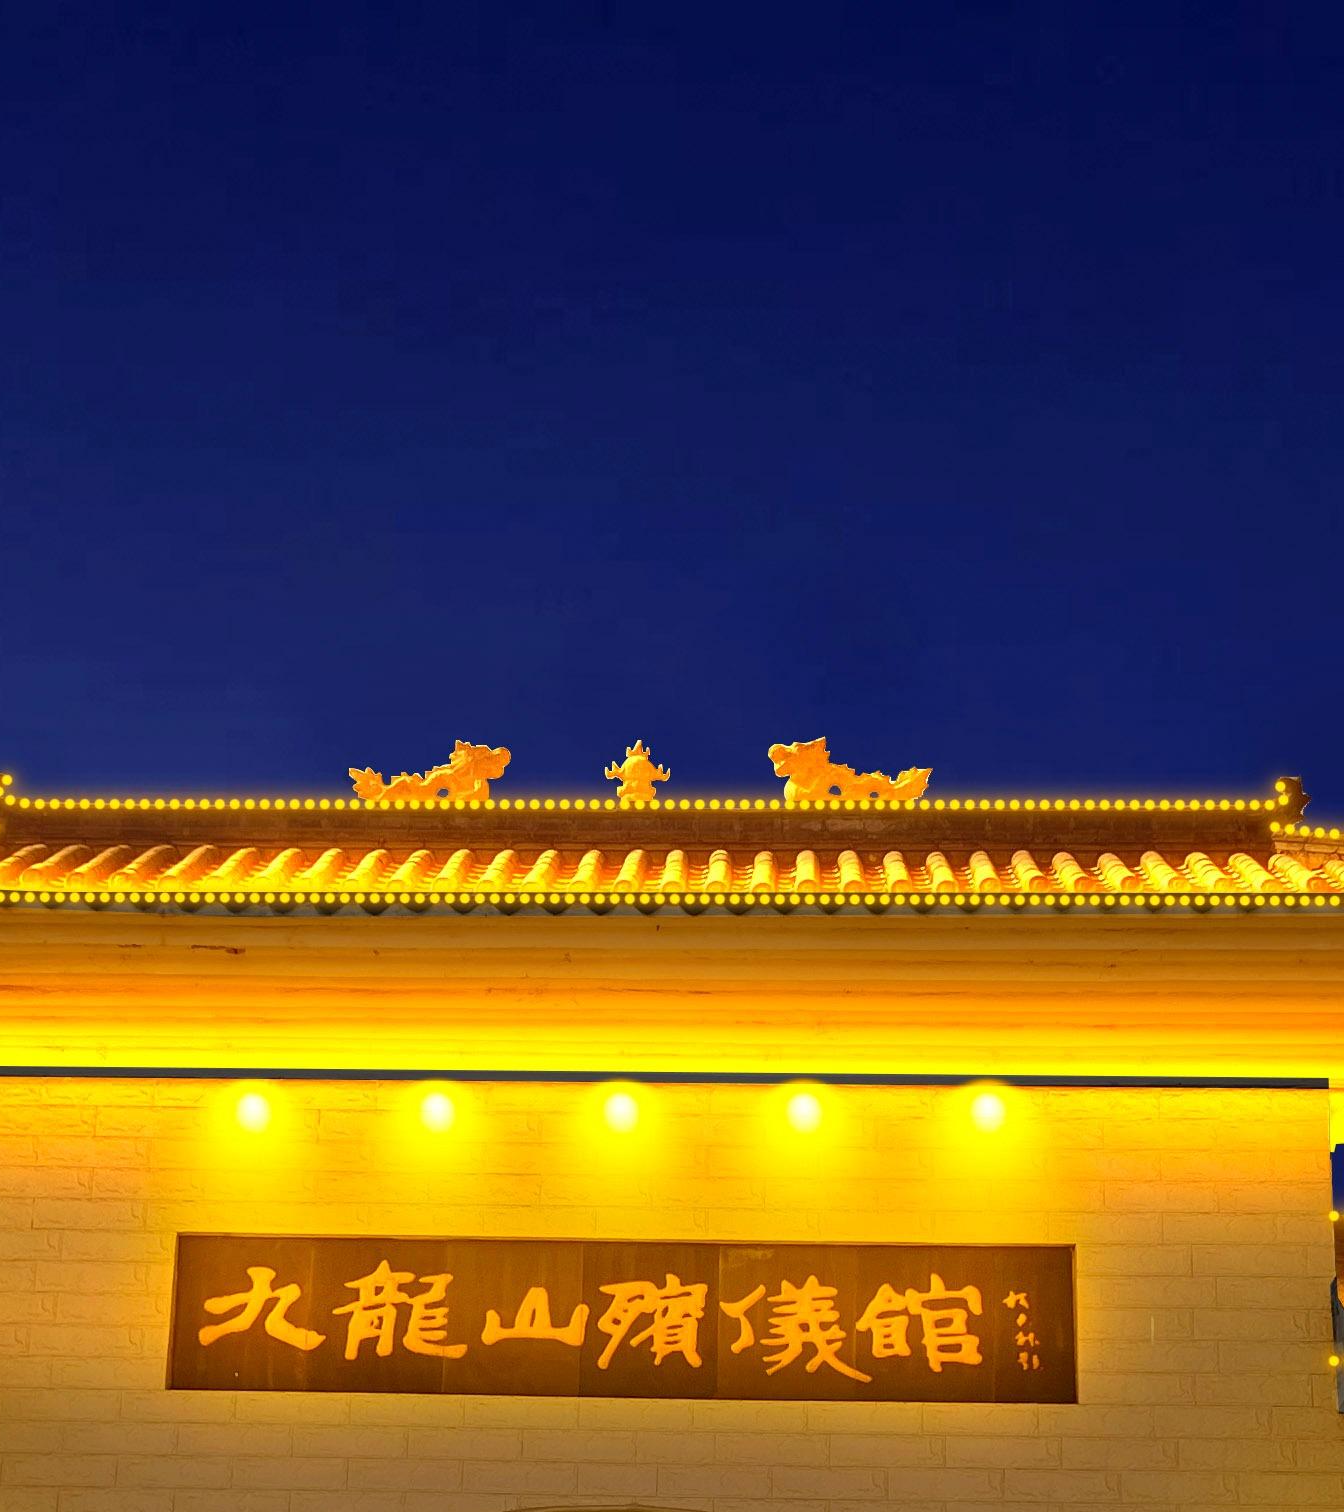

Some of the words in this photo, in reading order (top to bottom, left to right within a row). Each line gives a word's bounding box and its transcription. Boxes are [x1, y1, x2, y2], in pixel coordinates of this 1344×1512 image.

[198, 1259, 983, 1383] 九龍山殯儀館
